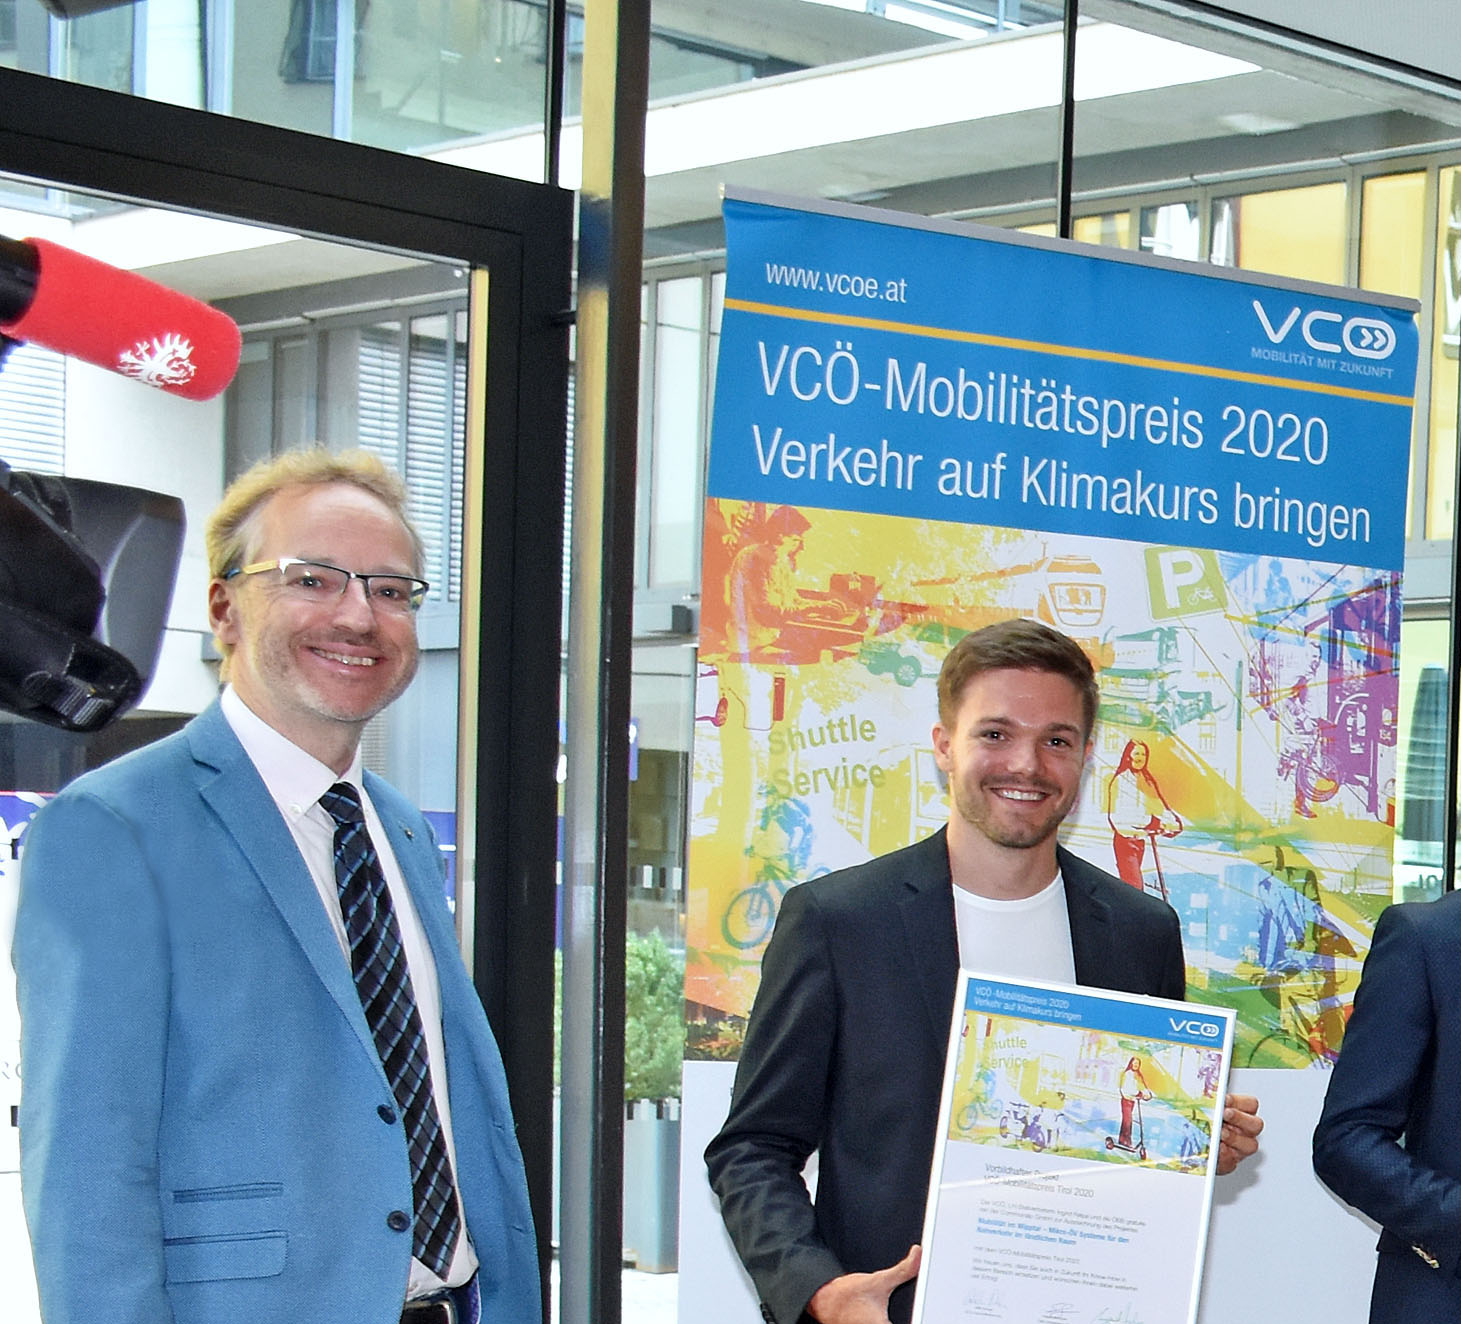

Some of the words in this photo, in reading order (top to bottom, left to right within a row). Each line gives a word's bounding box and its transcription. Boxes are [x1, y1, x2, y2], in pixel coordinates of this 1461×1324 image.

[765, 262, 908, 303] www.vcoe.at
[1251, 347, 1314, 368] MOBILITÄT
[1317, 357, 1337, 369] MIT
[1339, 361, 1394, 379] ZUKUNFT
[758, 340, 1204, 449] VCÖ-Mobilitätspreis
[1220, 404, 1329, 466] 2020
[752, 424, 923, 491] Verkehr
[937, 452, 1008, 500] auf
[1021, 455, 1219, 525] Klimakurs
[1234, 481, 1372, 547] bringen
[1158, 550, 1204, 609] P
[1073, 1187, 1094, 1198] 2020
